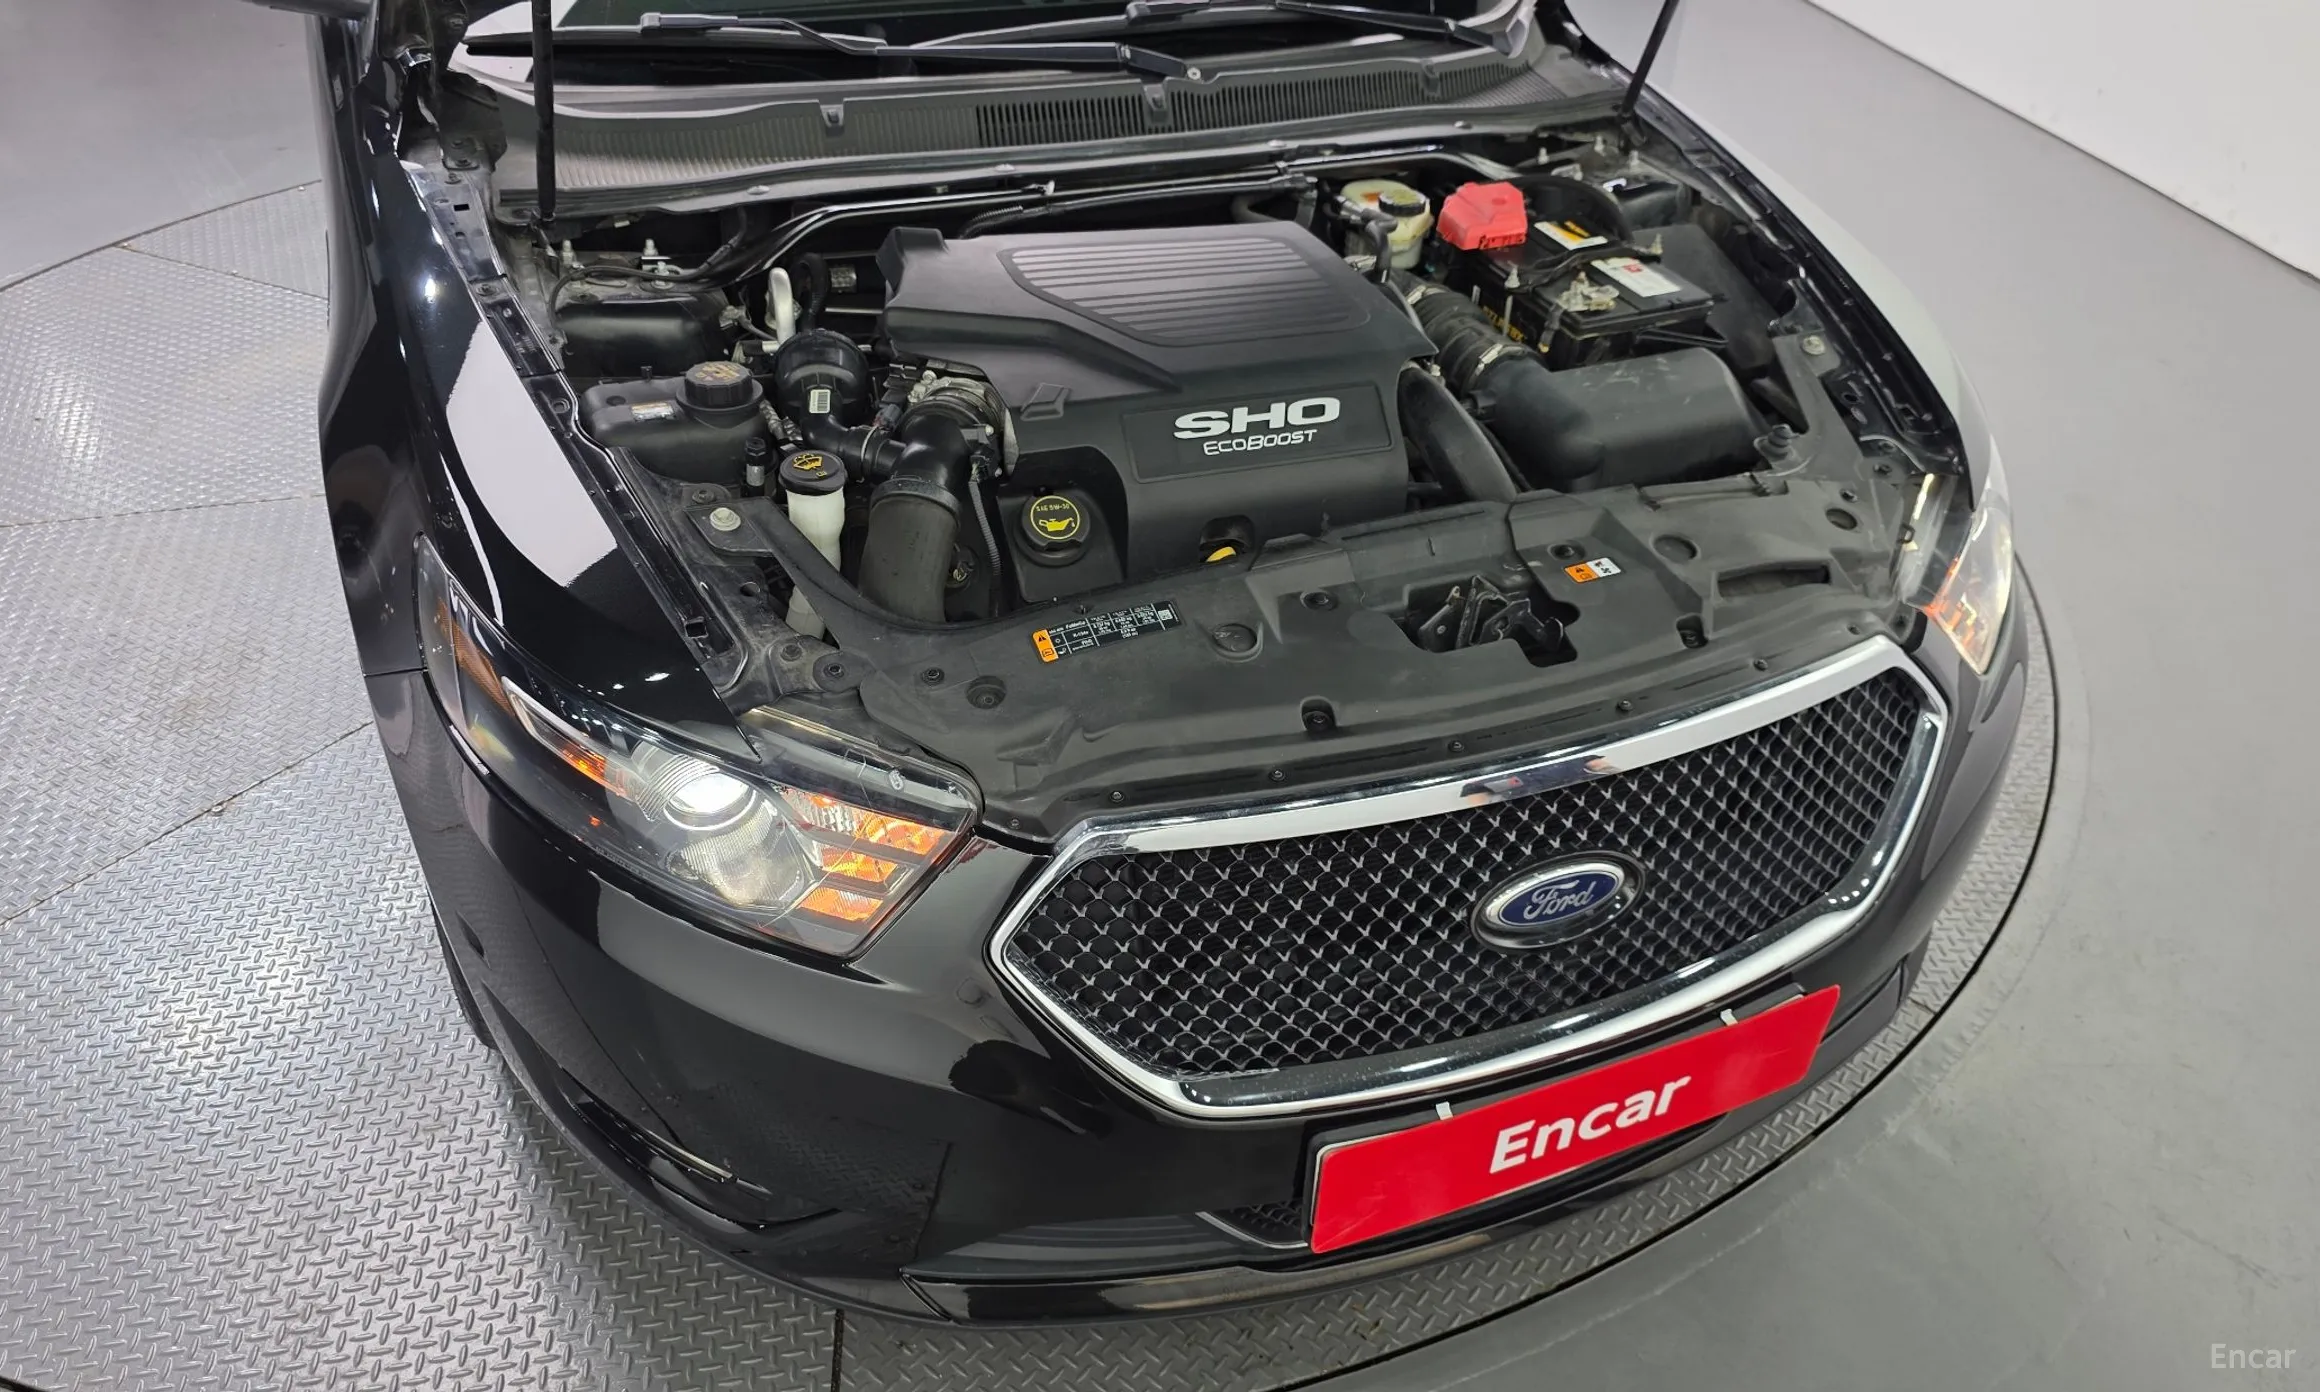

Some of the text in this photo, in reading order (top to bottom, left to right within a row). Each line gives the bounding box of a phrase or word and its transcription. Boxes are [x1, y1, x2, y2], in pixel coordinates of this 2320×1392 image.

[1173, 396, 1341, 439] SHO
[1049, 503, 1071, 511] 5W-30
[1523, 879, 1597, 920] Ford
[1489, 1075, 1691, 1175] Encar
